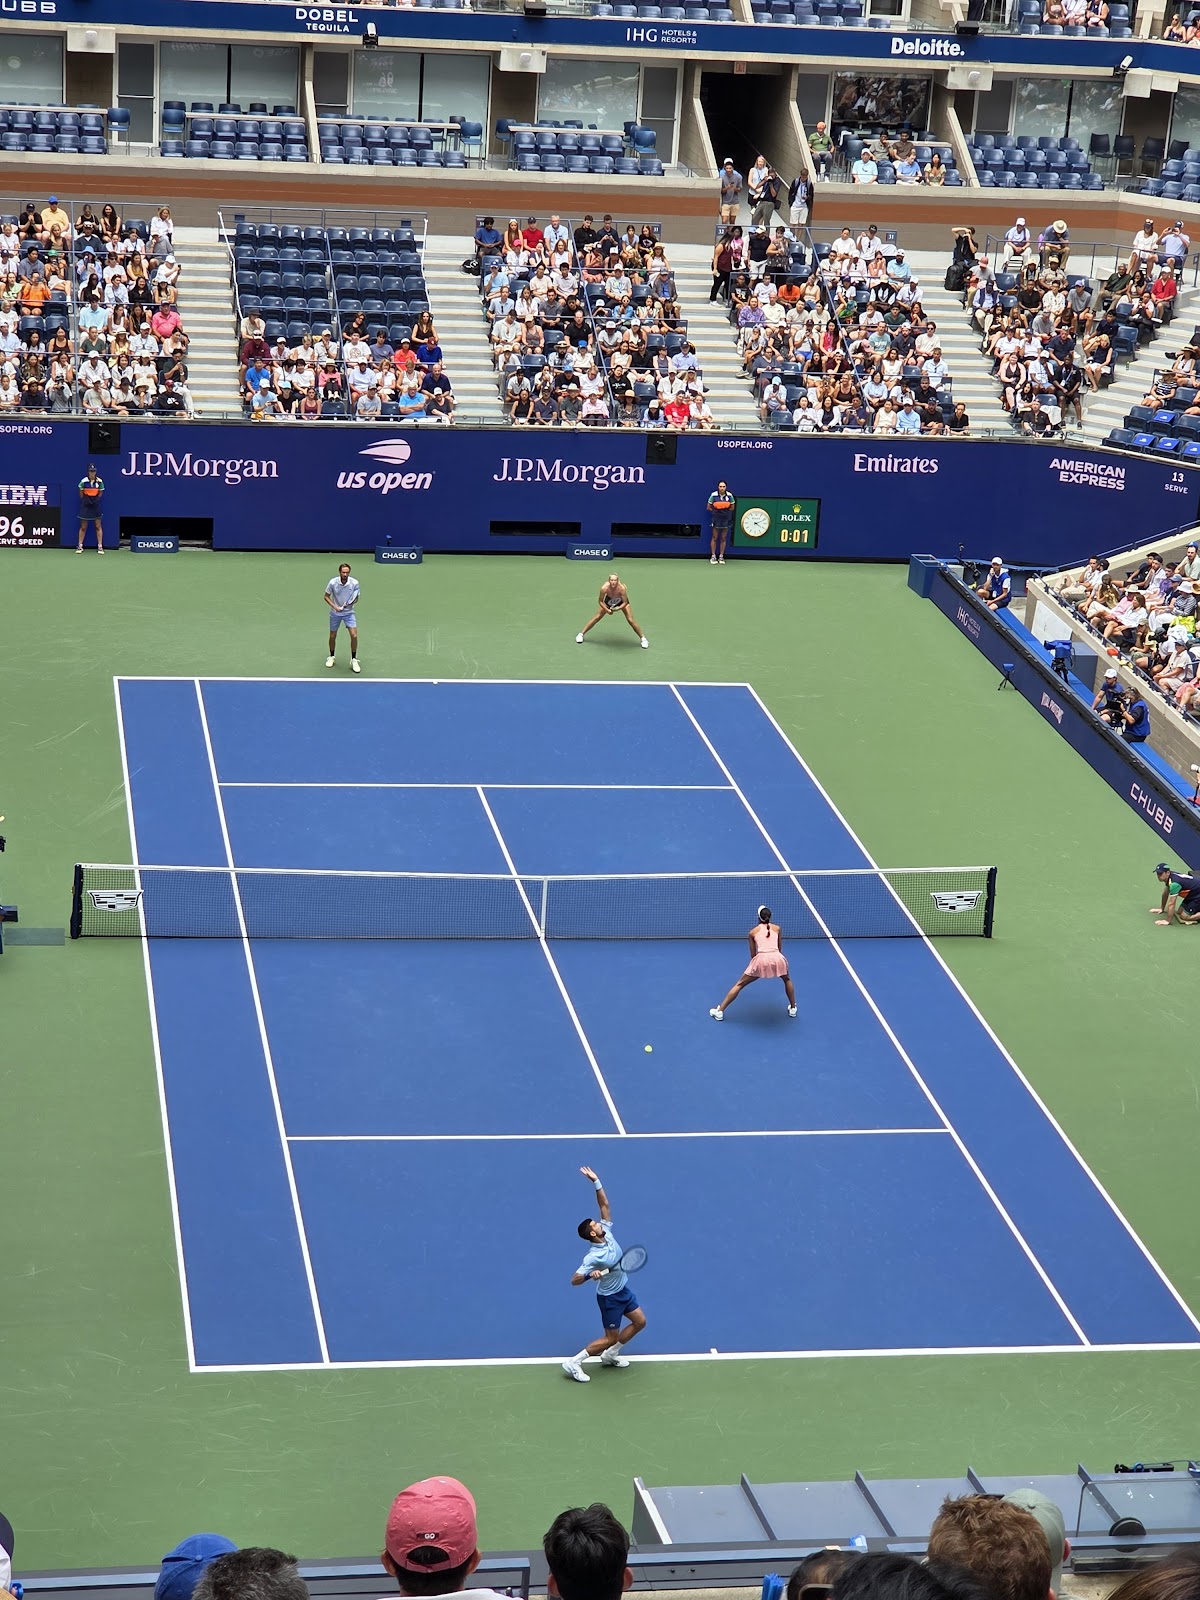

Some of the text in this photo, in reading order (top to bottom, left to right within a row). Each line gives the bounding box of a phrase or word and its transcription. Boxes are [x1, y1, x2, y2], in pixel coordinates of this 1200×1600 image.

[295, 8, 359, 22] DOBEL
[306, 23, 350, 32] TEQUILA
[626, 28, 658, 42] IHG
[891, 37, 965, 56] Deloitte.
[717, 440, 773, 449] USOPEN.ORG
[121, 452, 279, 485] J.P.Morgan
[854, 453, 939, 473] Emirates
[1050, 458, 1126, 479] AMERICAN
[493, 457, 646, 491] J.P.Morgan
[1059, 471, 1125, 491] EXPRESS
[1172, 471, 1185, 483] 13
[336, 472, 433, 495] us open
[1164, 484, 1188, 494] SERVE
[0, 485, 47, 505] IBM
[781, 514, 812, 522] ROLEX
[32, 528, 55, 536] MPH
[781, 529, 808, 543] 0:01
[137, 541, 165, 549] CHASE
[1130, 783, 1174, 834] CHUBB
